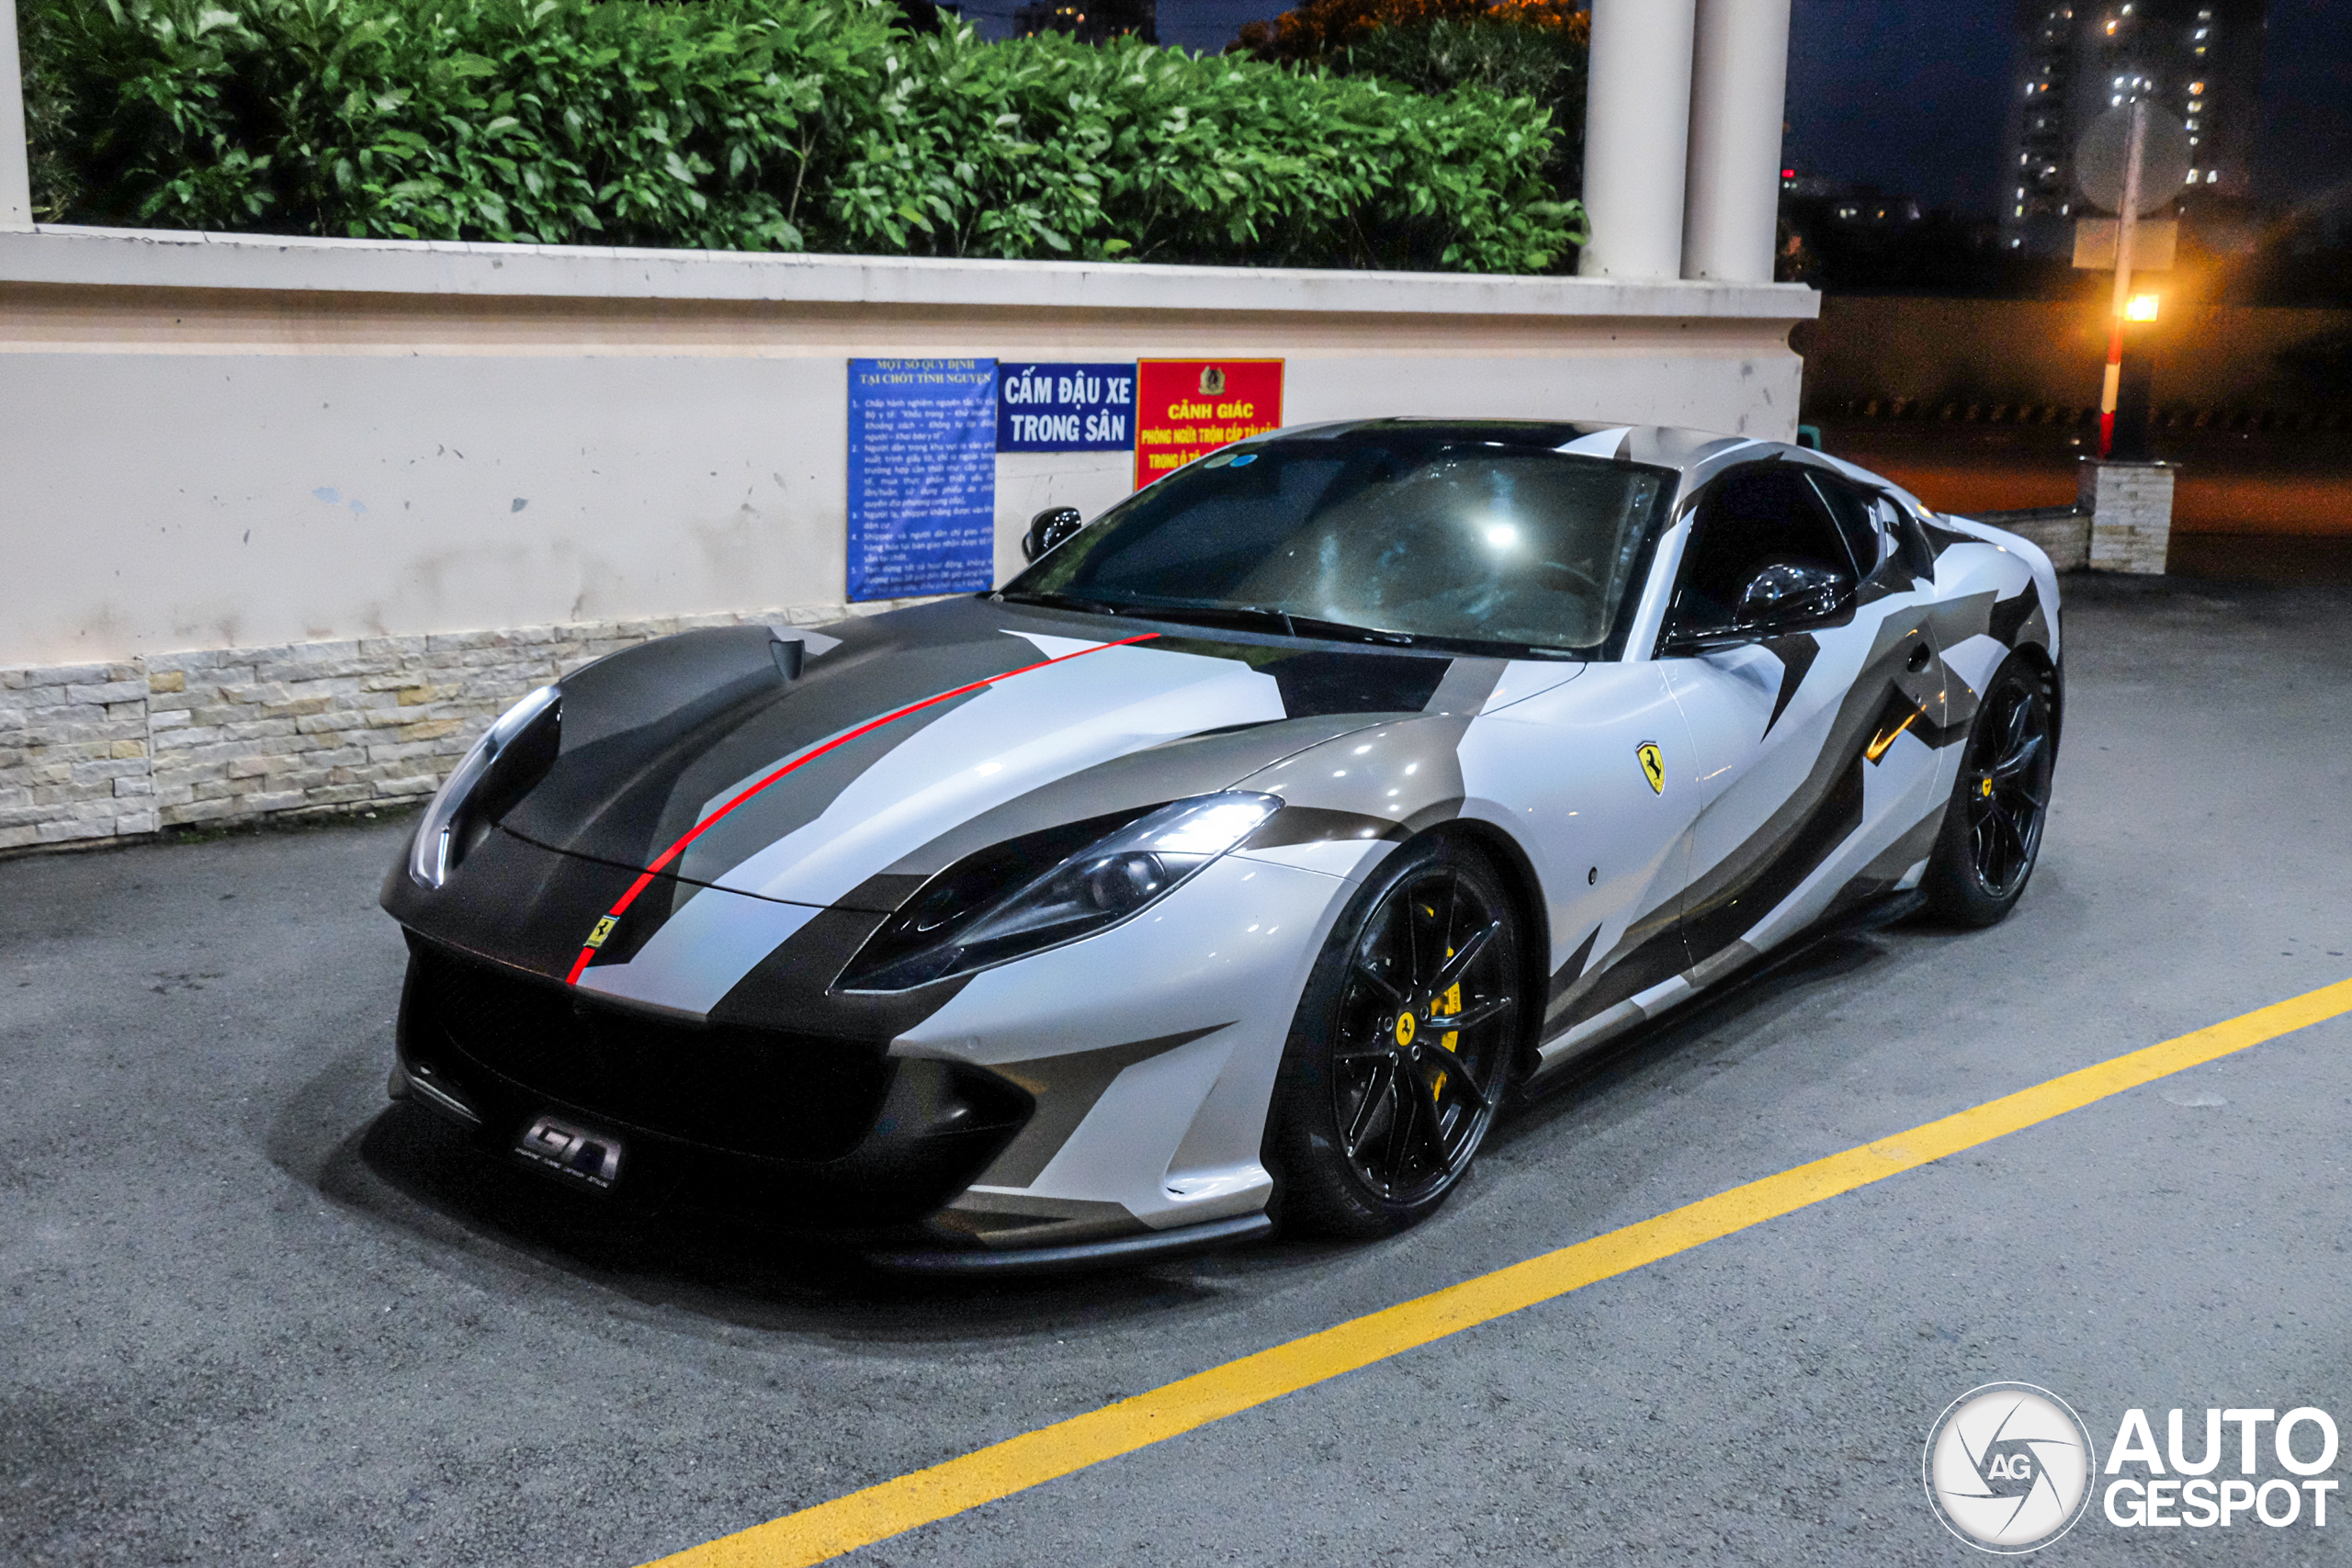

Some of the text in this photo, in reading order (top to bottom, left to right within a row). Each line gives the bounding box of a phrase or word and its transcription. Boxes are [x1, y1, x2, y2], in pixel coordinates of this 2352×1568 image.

[1004, 366, 1132, 411] CẤM ĐẬU XE
[1168, 398, 1254, 420] CẢNH GIÁC
[1011, 408, 1125, 442] TRONG SÂN
[1141, 425, 1172, 445] PHÒNG
[1173, 424, 1197, 444] NGỪA
[1199, 424, 1225, 446] TRỘM
[1226, 422, 1243, 443] CẤP
[1148, 453, 1179, 469] TRONG
